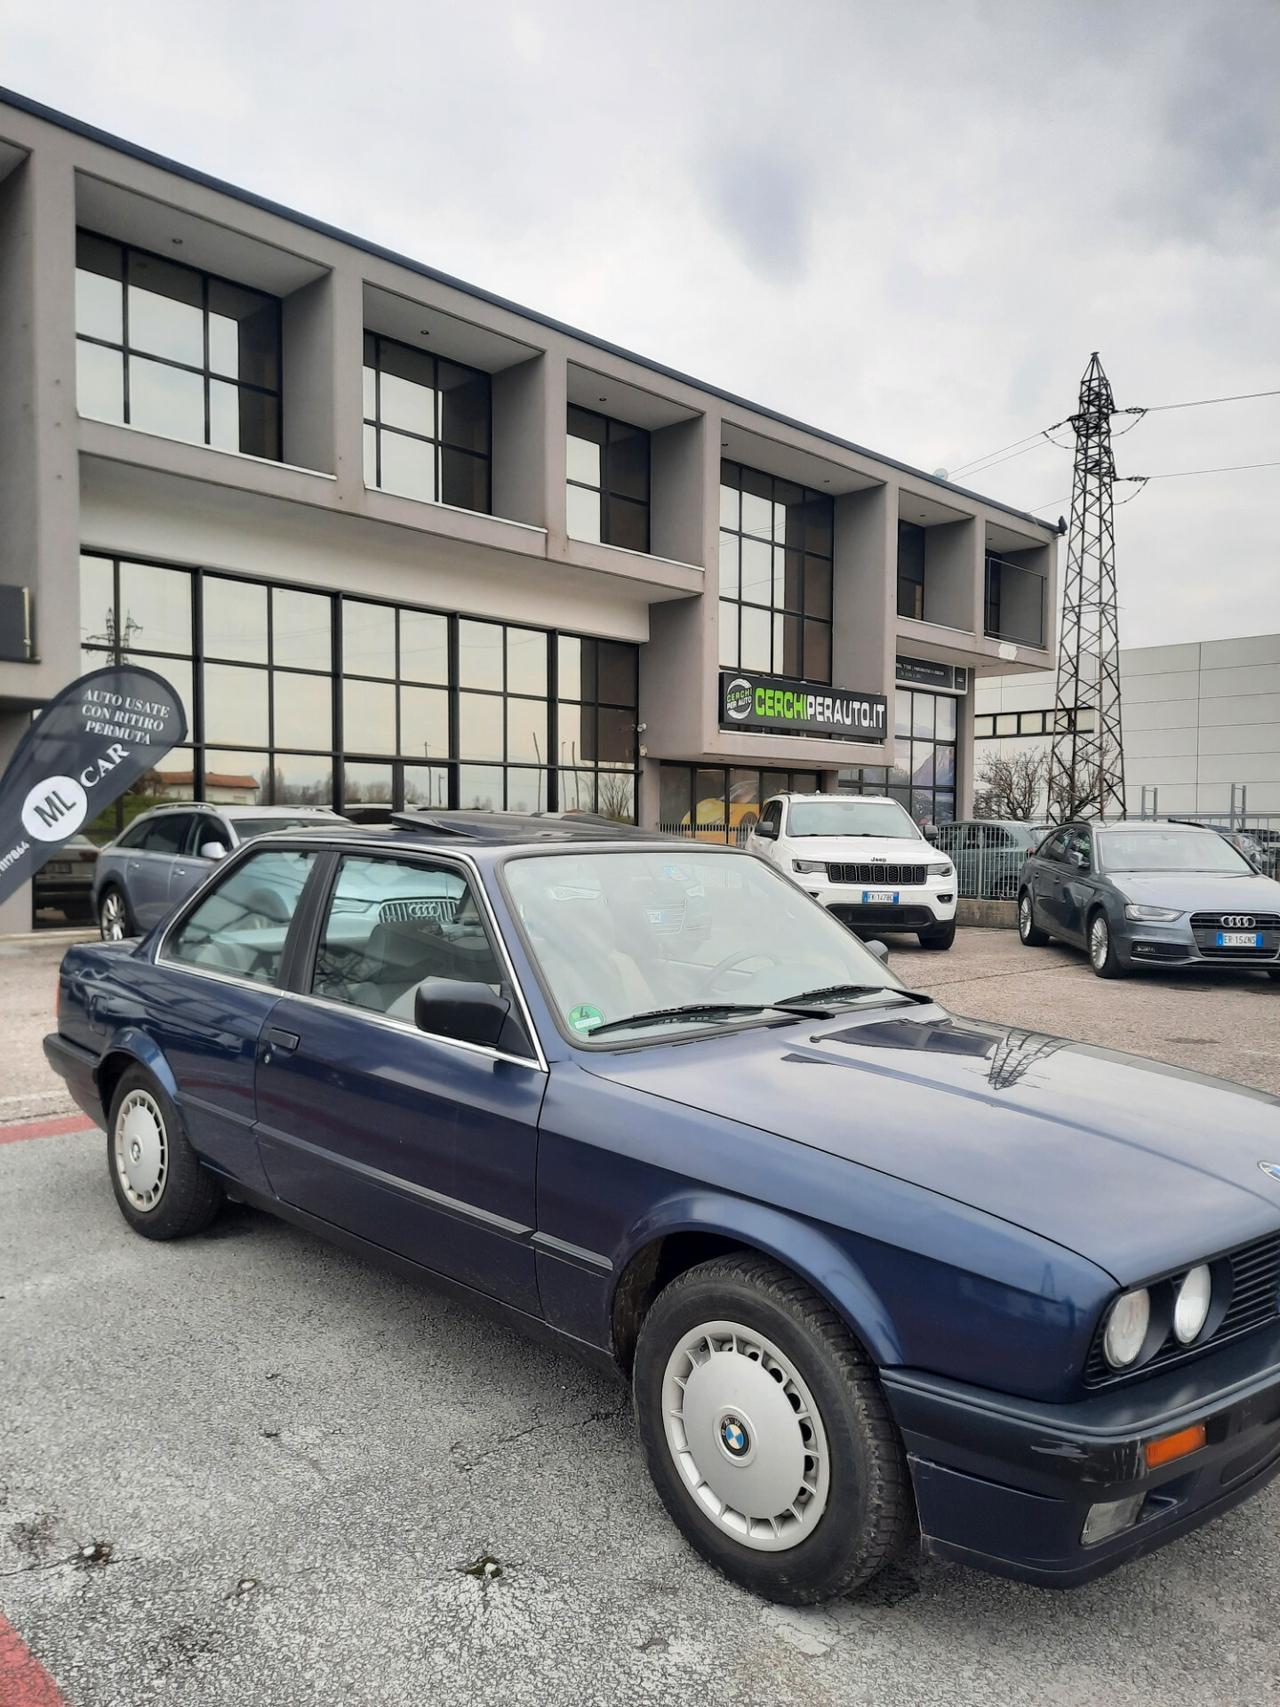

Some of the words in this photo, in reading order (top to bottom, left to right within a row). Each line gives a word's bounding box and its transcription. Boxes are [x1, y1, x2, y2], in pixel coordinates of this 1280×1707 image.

[81, 704, 111, 720] CON
[114, 711, 164, 732] RITIRO
[84, 689, 122, 708] AUTO
[124, 697, 170, 719] USATE
[85, 720, 152, 745] PERMUTA
[80, 742, 130, 788] CAR
[33, 790, 77, 828] ML
